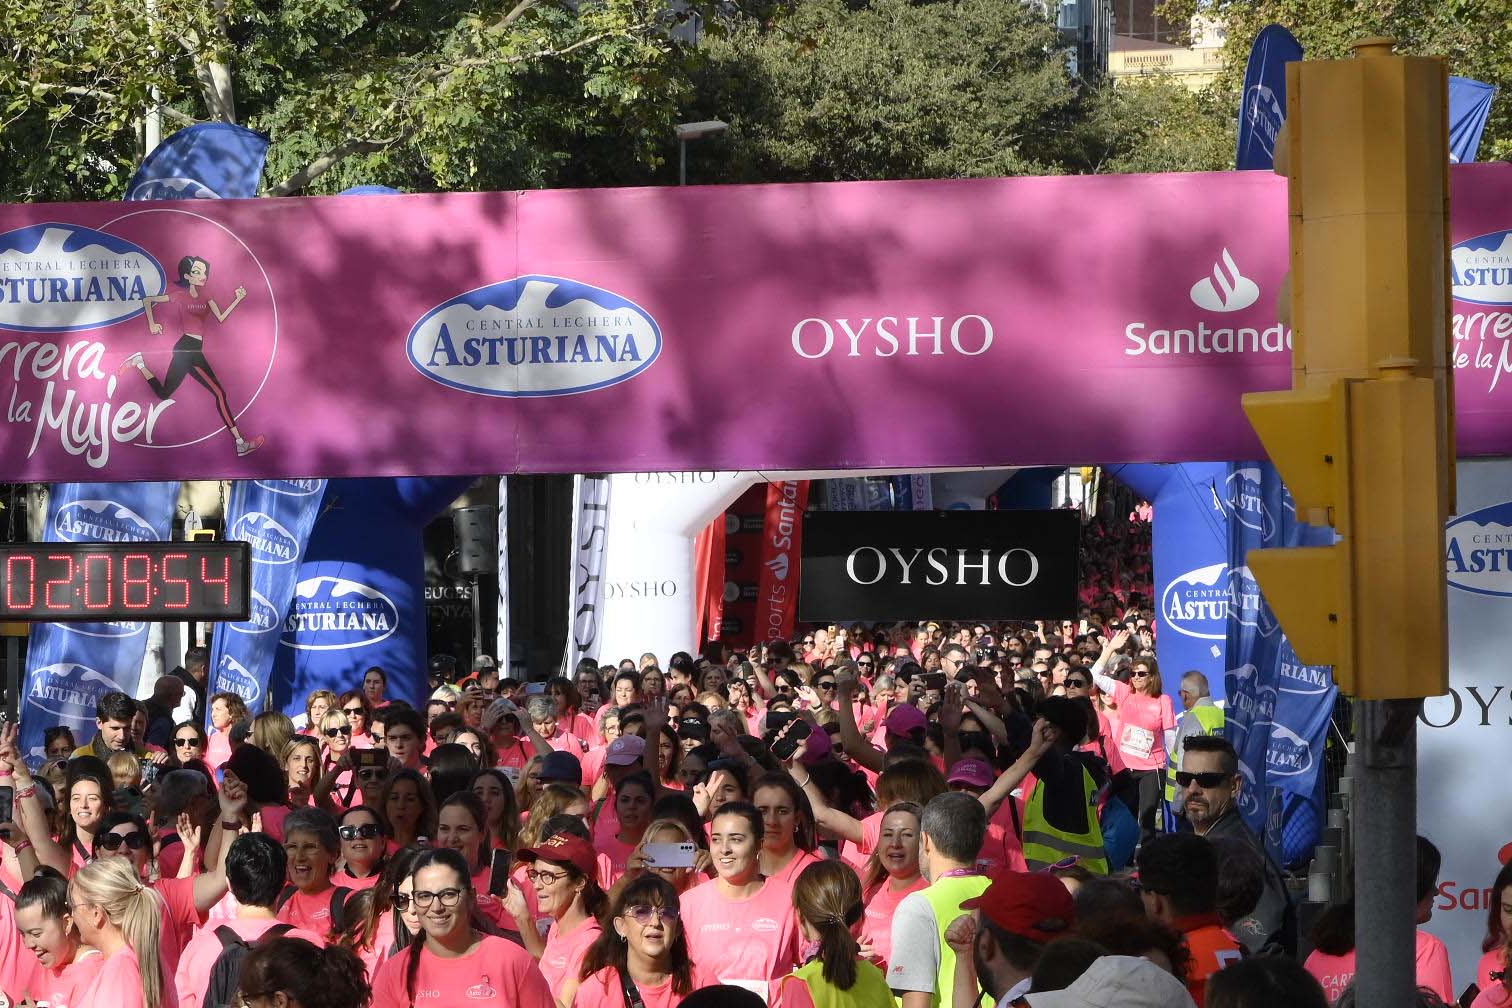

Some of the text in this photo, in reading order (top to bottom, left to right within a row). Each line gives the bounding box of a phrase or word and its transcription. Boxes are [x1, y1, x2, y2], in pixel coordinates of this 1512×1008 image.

[68, 258, 141, 270] LECHERA
[466, 316, 634, 331] CENTRAL LECHERA
[791, 315, 994, 358] OYSHO
[426, 323, 642, 367] ASTURIANA
[7, 388, 32, 423] la
[28, 375, 176, 469] Mujer
[7, 553, 230, 608] 02:08:54
[846, 546, 1039, 587] OYSHO
[296, 602, 331, 610] ENTRAL
